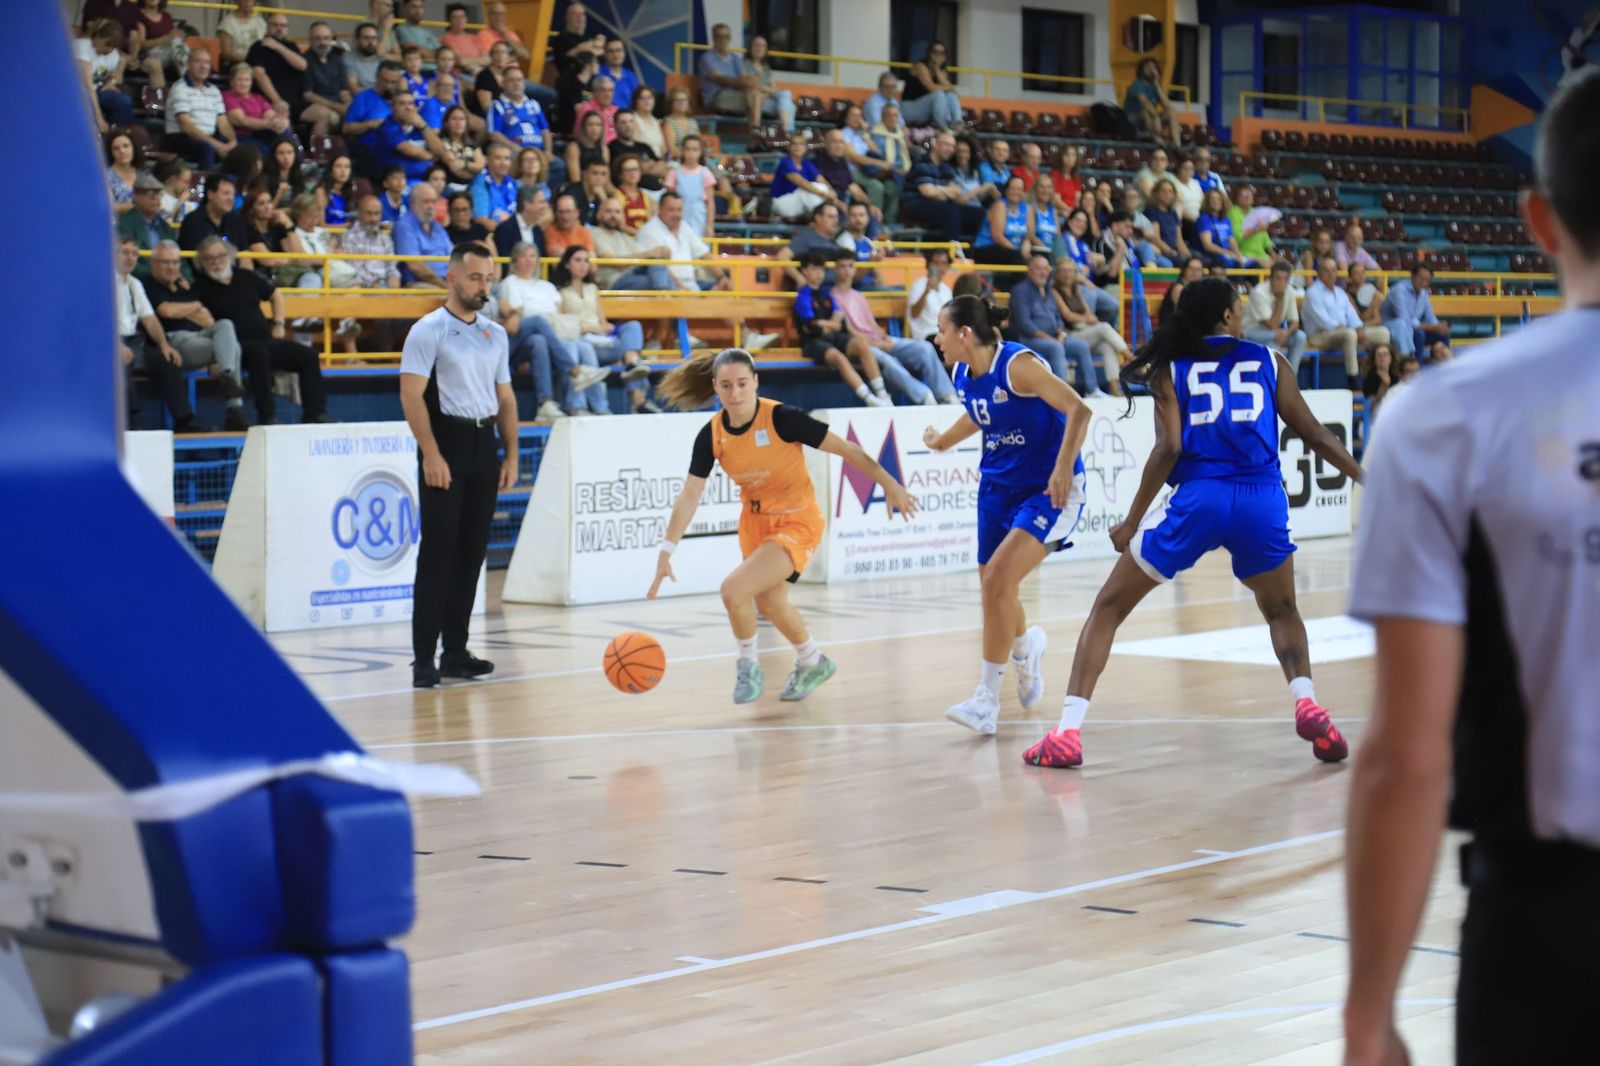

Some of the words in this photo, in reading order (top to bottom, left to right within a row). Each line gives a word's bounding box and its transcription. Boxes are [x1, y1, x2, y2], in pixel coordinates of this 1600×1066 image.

[971, 398, 991, 425] 13
[1187, 361, 1264, 425] 55
[332, 497, 420, 549] C&M
[575, 515, 668, 553] MARTA
